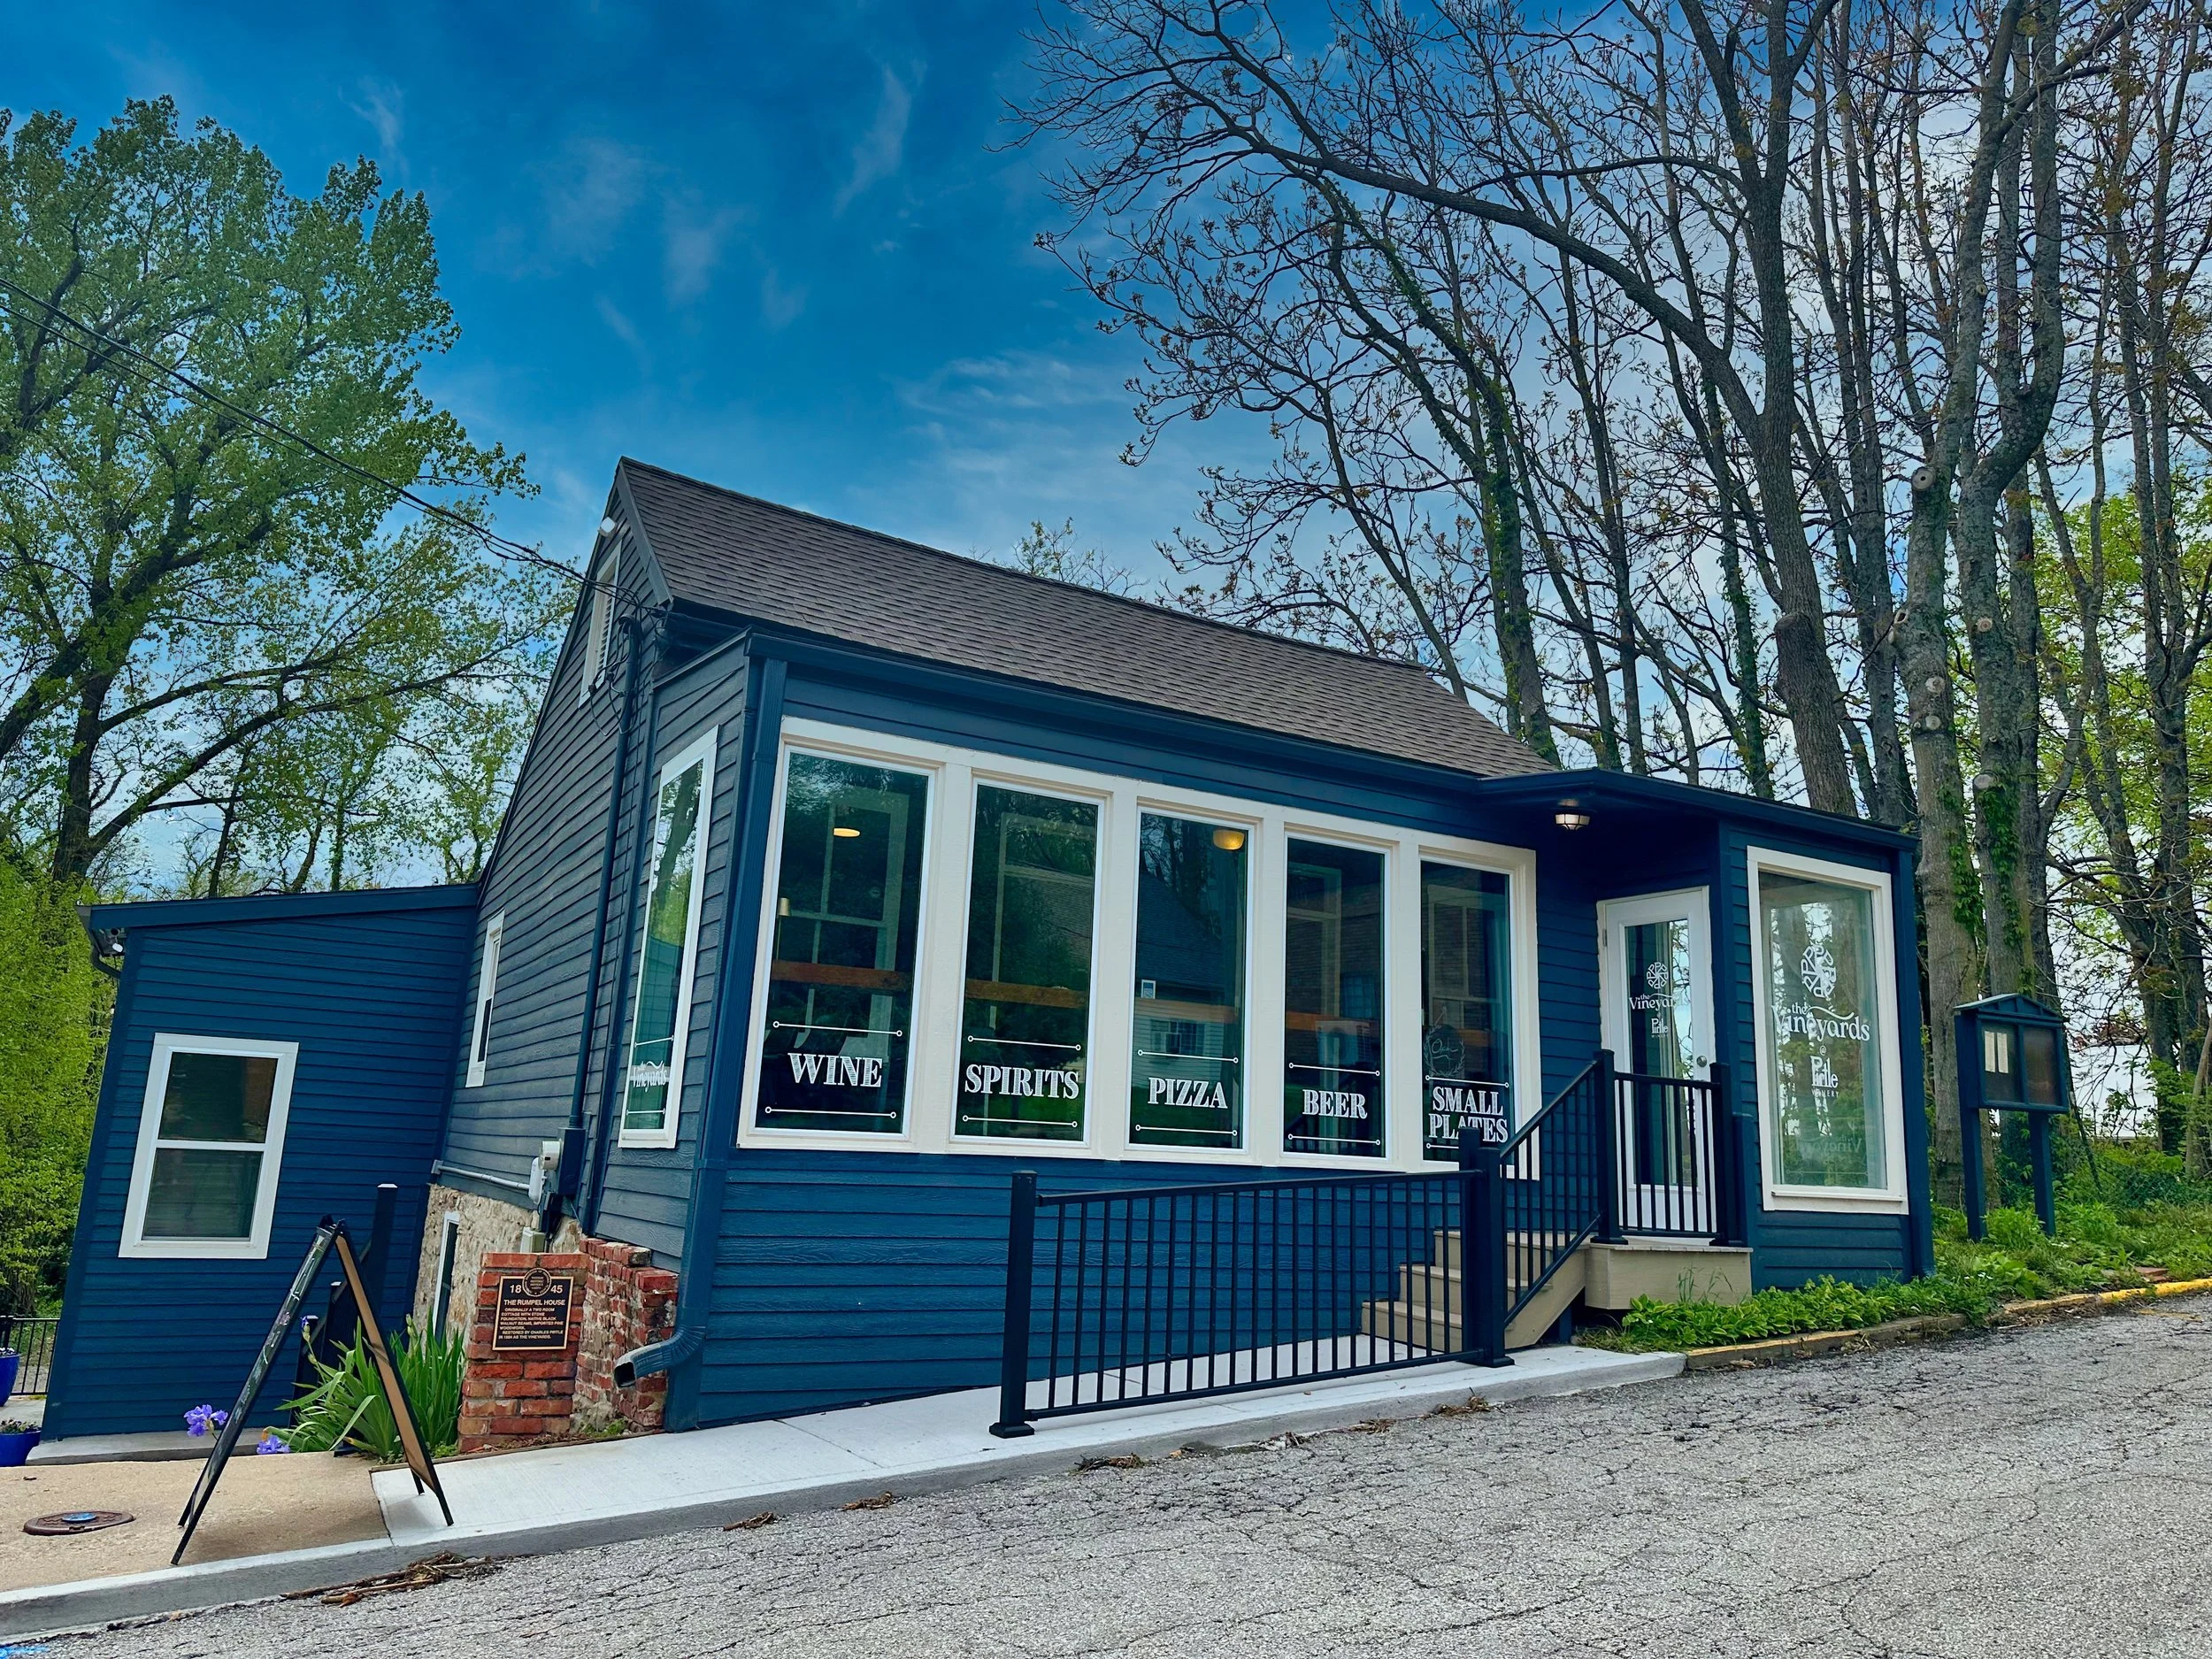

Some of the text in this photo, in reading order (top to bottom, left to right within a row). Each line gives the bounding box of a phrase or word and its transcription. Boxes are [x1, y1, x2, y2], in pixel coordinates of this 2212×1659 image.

[1771, 1004, 1870, 1041] Vineyards
[1792, 1002, 1809, 1015] the
[787, 1052, 882, 1087] WINE
[964, 1064, 1079, 1099] SPIRITS
[1148, 1077, 1228, 1109] PIZZA
[1302, 1089, 1368, 1118] BEER
[1432, 1087, 1503, 1117] SMALL
[510, 1285, 522, 1294] 18
[550, 1285, 563, 1294] 45
